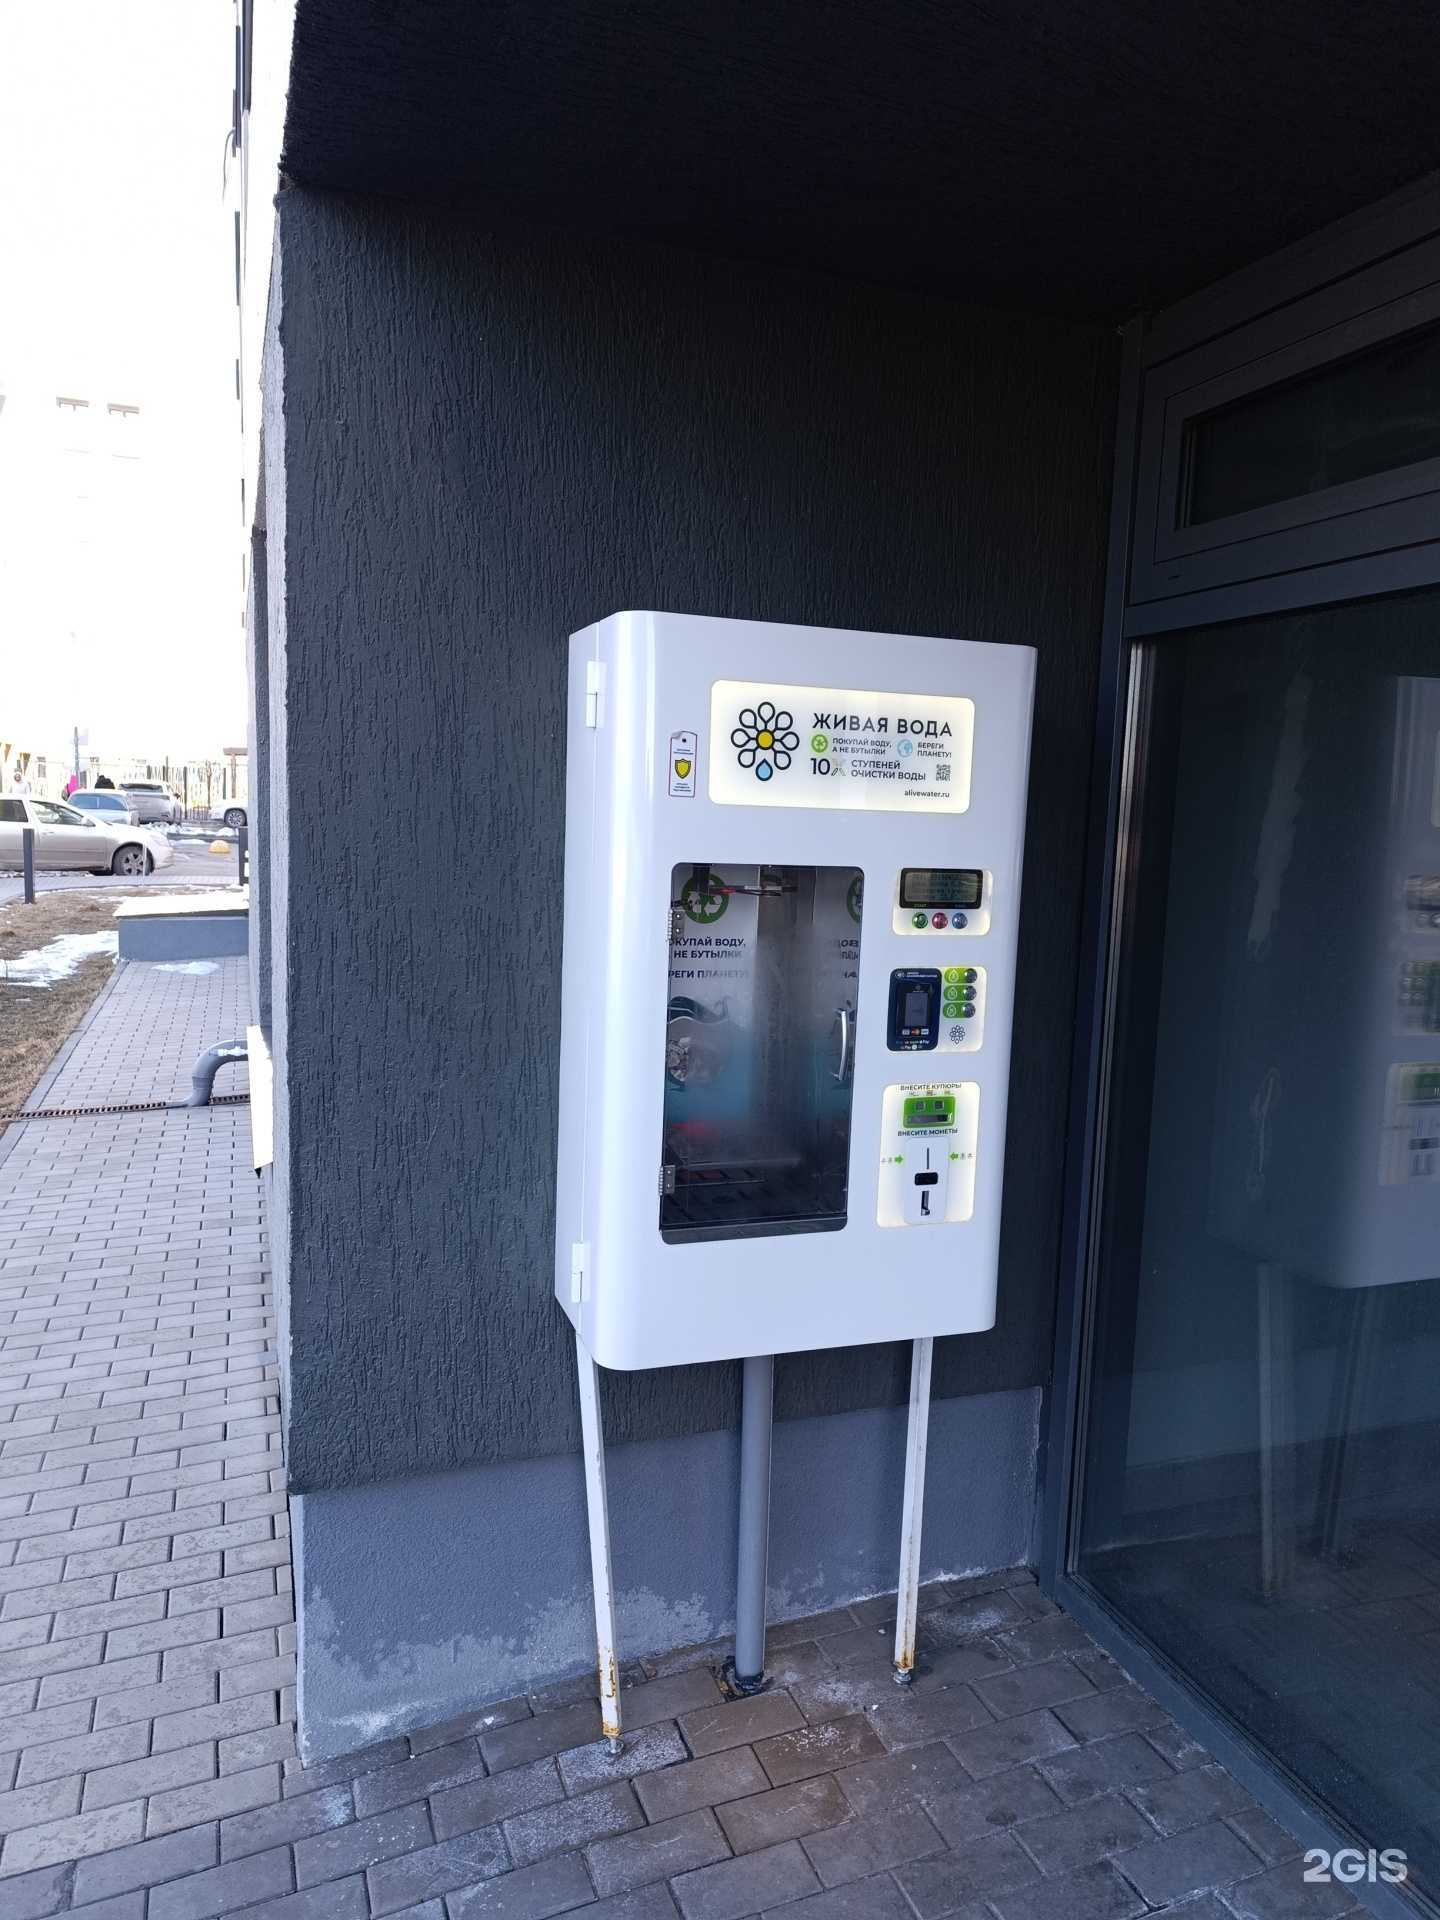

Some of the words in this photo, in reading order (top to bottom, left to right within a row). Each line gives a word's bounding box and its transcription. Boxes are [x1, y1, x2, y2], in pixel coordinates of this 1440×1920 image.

[812, 713, 889, 733] ЖИВАЯ
[896, 718, 953, 738] ВОДА
[832, 737, 869, 746] ПОКУПАЙ
[870, 740, 892, 749] ВОДУ,
[851, 748, 886, 756] БУТЫЛКИ
[851, 759, 900, 770] СТУПЕНЕЙ
[851, 770, 895, 780] ОЧИСТКИ
[897, 772, 926, 782] ВОДЫ
[904, 789, 950, 798] alivewater.ru
[669, 937, 712, 947] ОКУПАЙ
[715, 938, 746, 948] ВОДУ,
[673, 950, 688, 959] НЕ
[691, 950, 742, 959] БУТЫЛКИ
[668, 970, 694, 978] РЕГИ
[897, 1129, 928, 1137] ВНЕСИТЕ
[928, 1128, 958, 1136] МОНЕТЫ
